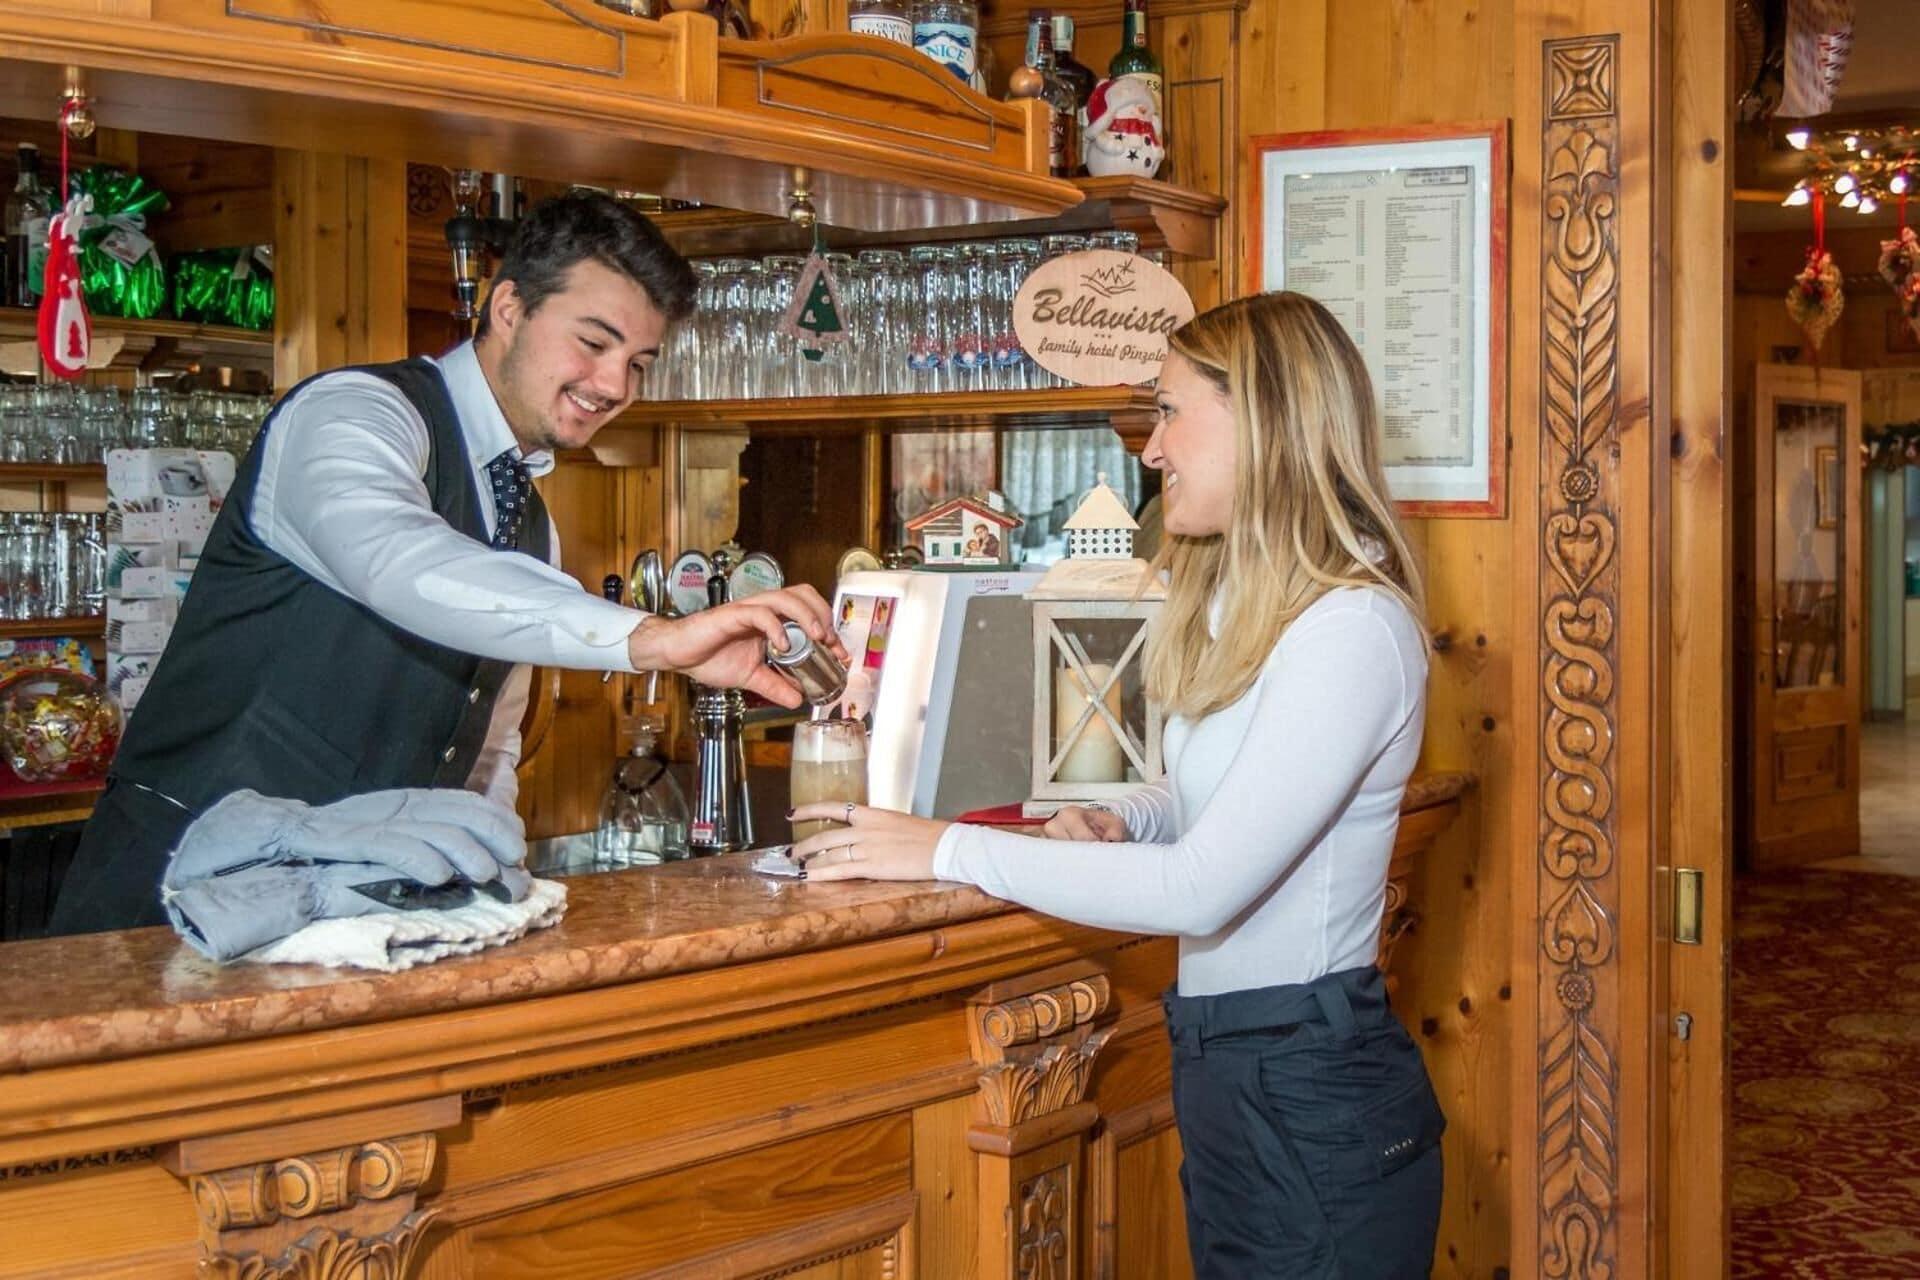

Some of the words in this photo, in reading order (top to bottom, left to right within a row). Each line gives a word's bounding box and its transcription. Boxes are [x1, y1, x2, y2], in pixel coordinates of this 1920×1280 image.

[1032, 288, 1178, 334] Bellavista
[1038, 337, 1082, 357] family
[1085, 342, 1117, 358] hotel
